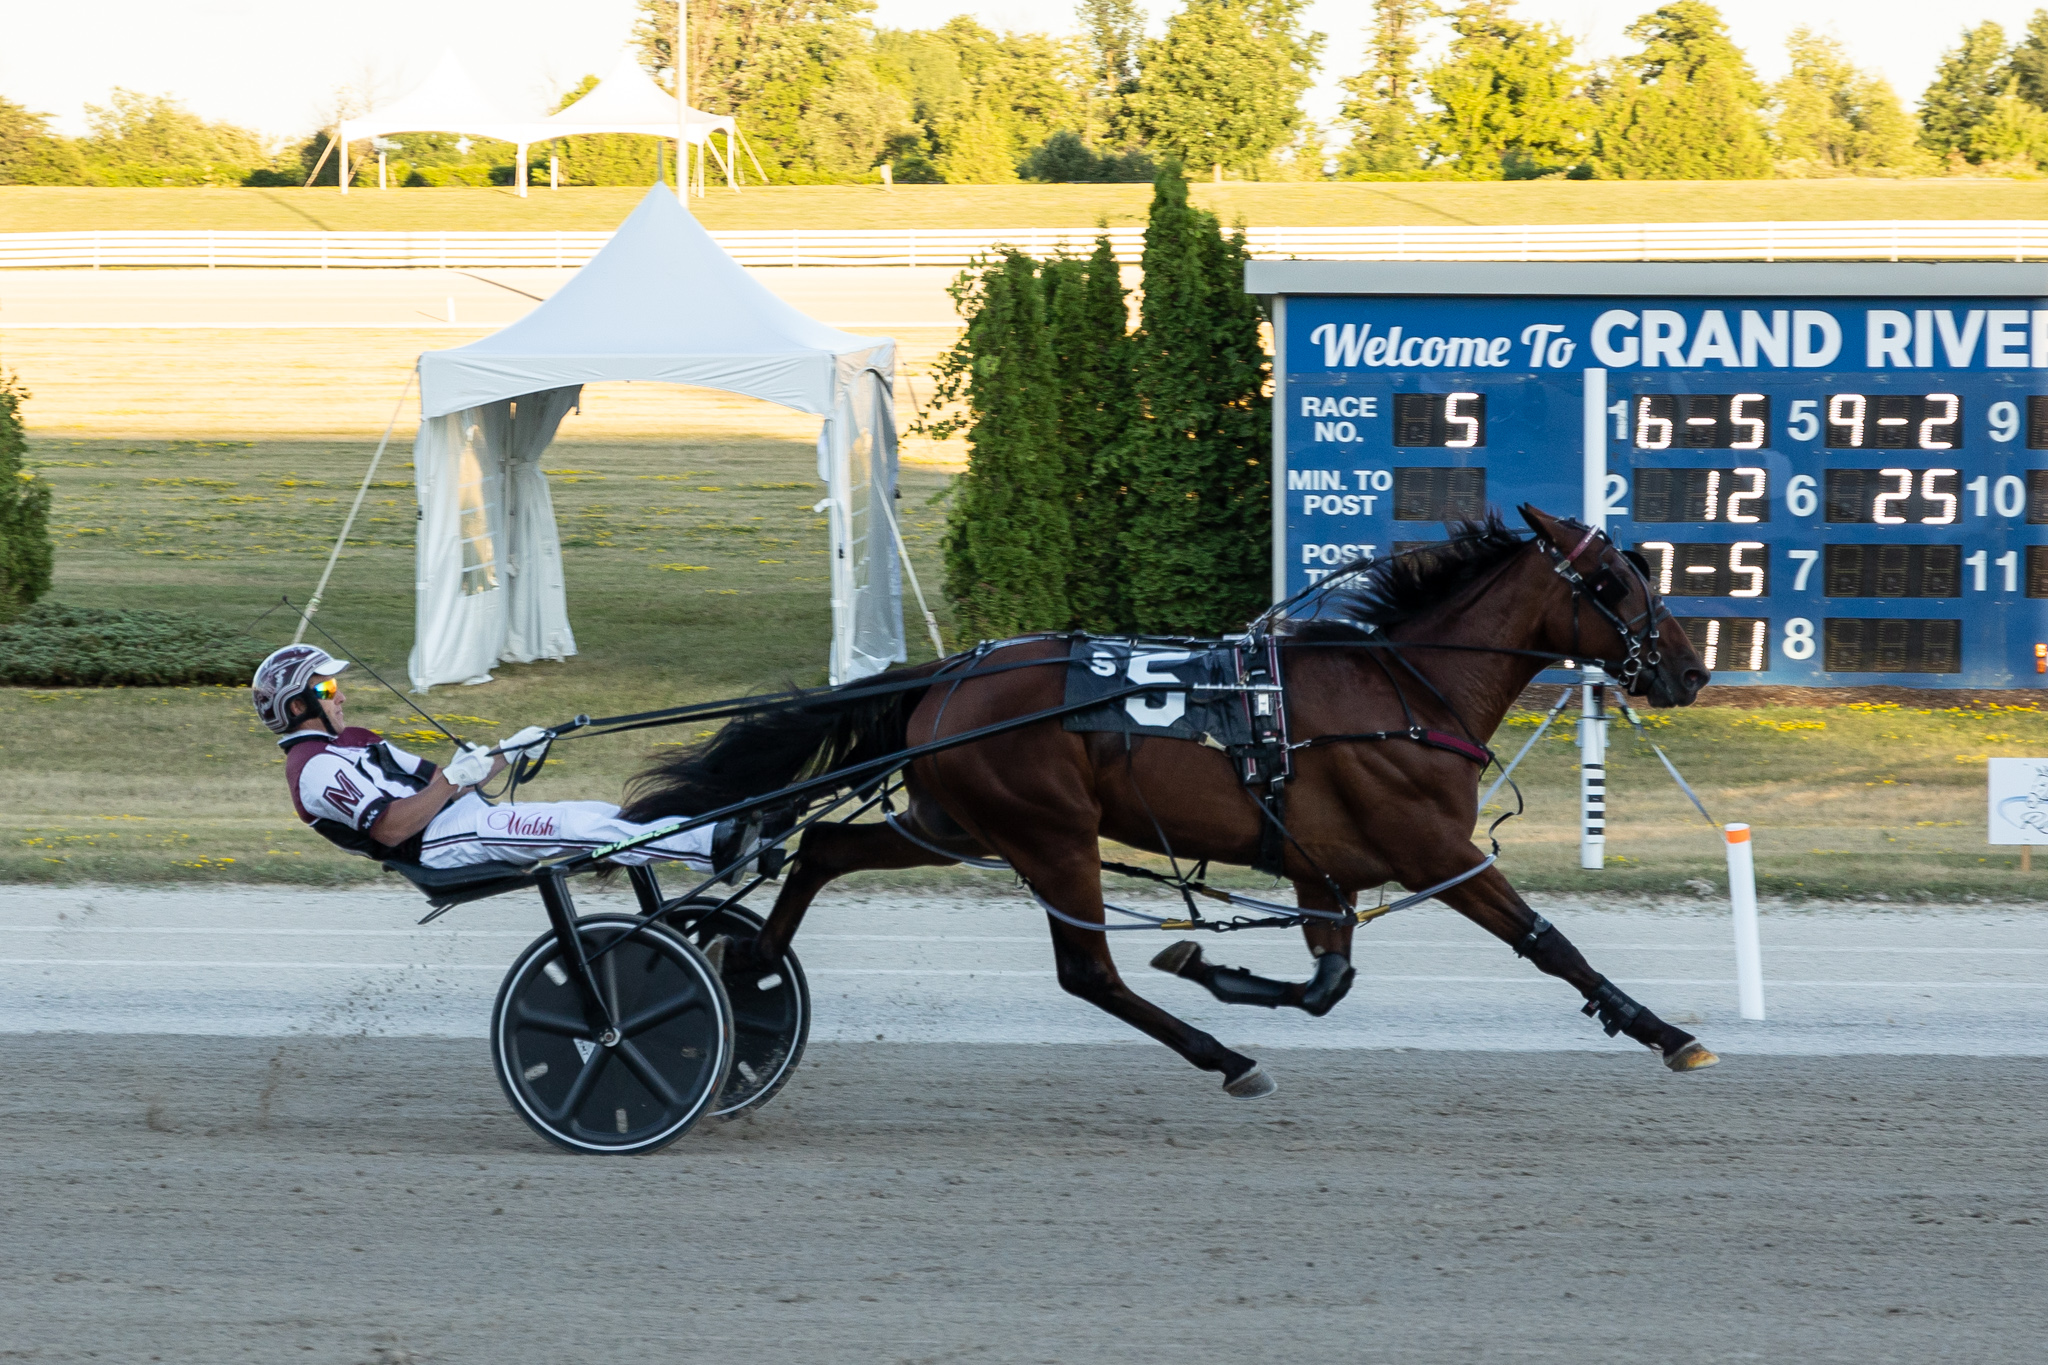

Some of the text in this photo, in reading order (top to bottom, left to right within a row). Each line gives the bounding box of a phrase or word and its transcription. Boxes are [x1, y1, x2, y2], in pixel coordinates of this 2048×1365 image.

[1310, 323, 1511, 367] Welcome
[1521, 323, 1576, 368] To
[1590, 309, 1842, 368] GRAND
[1302, 397, 1377, 418] RACE
[1444, 392, 1479, 448] 5
[1608, 400, 1628, 440] 1
[1787, 400, 1819, 441] 5
[1988, 401, 2019, 442] 9
[1315, 422, 1363, 443] NO.
[1288, 470, 1393, 491] MIN. TO
[1603, 474, 1628, 515] 2
[1704, 468, 1766, 523] 12
[1786, 474, 1818, 516] 6
[1873, 468, 1957, 524] 25
[1966, 476, 2026, 517] 10
[1304, 495, 1378, 516] POST
[1302, 543, 1377, 565] POST
[1788, 549, 1819, 591] 7
[1965, 550, 2018, 591] 11
[1782, 617, 1816, 660] 8
[1125, 651, 1191, 727] 5
[322, 768, 365, 820] M
[487, 809, 555, 837] Walsh
